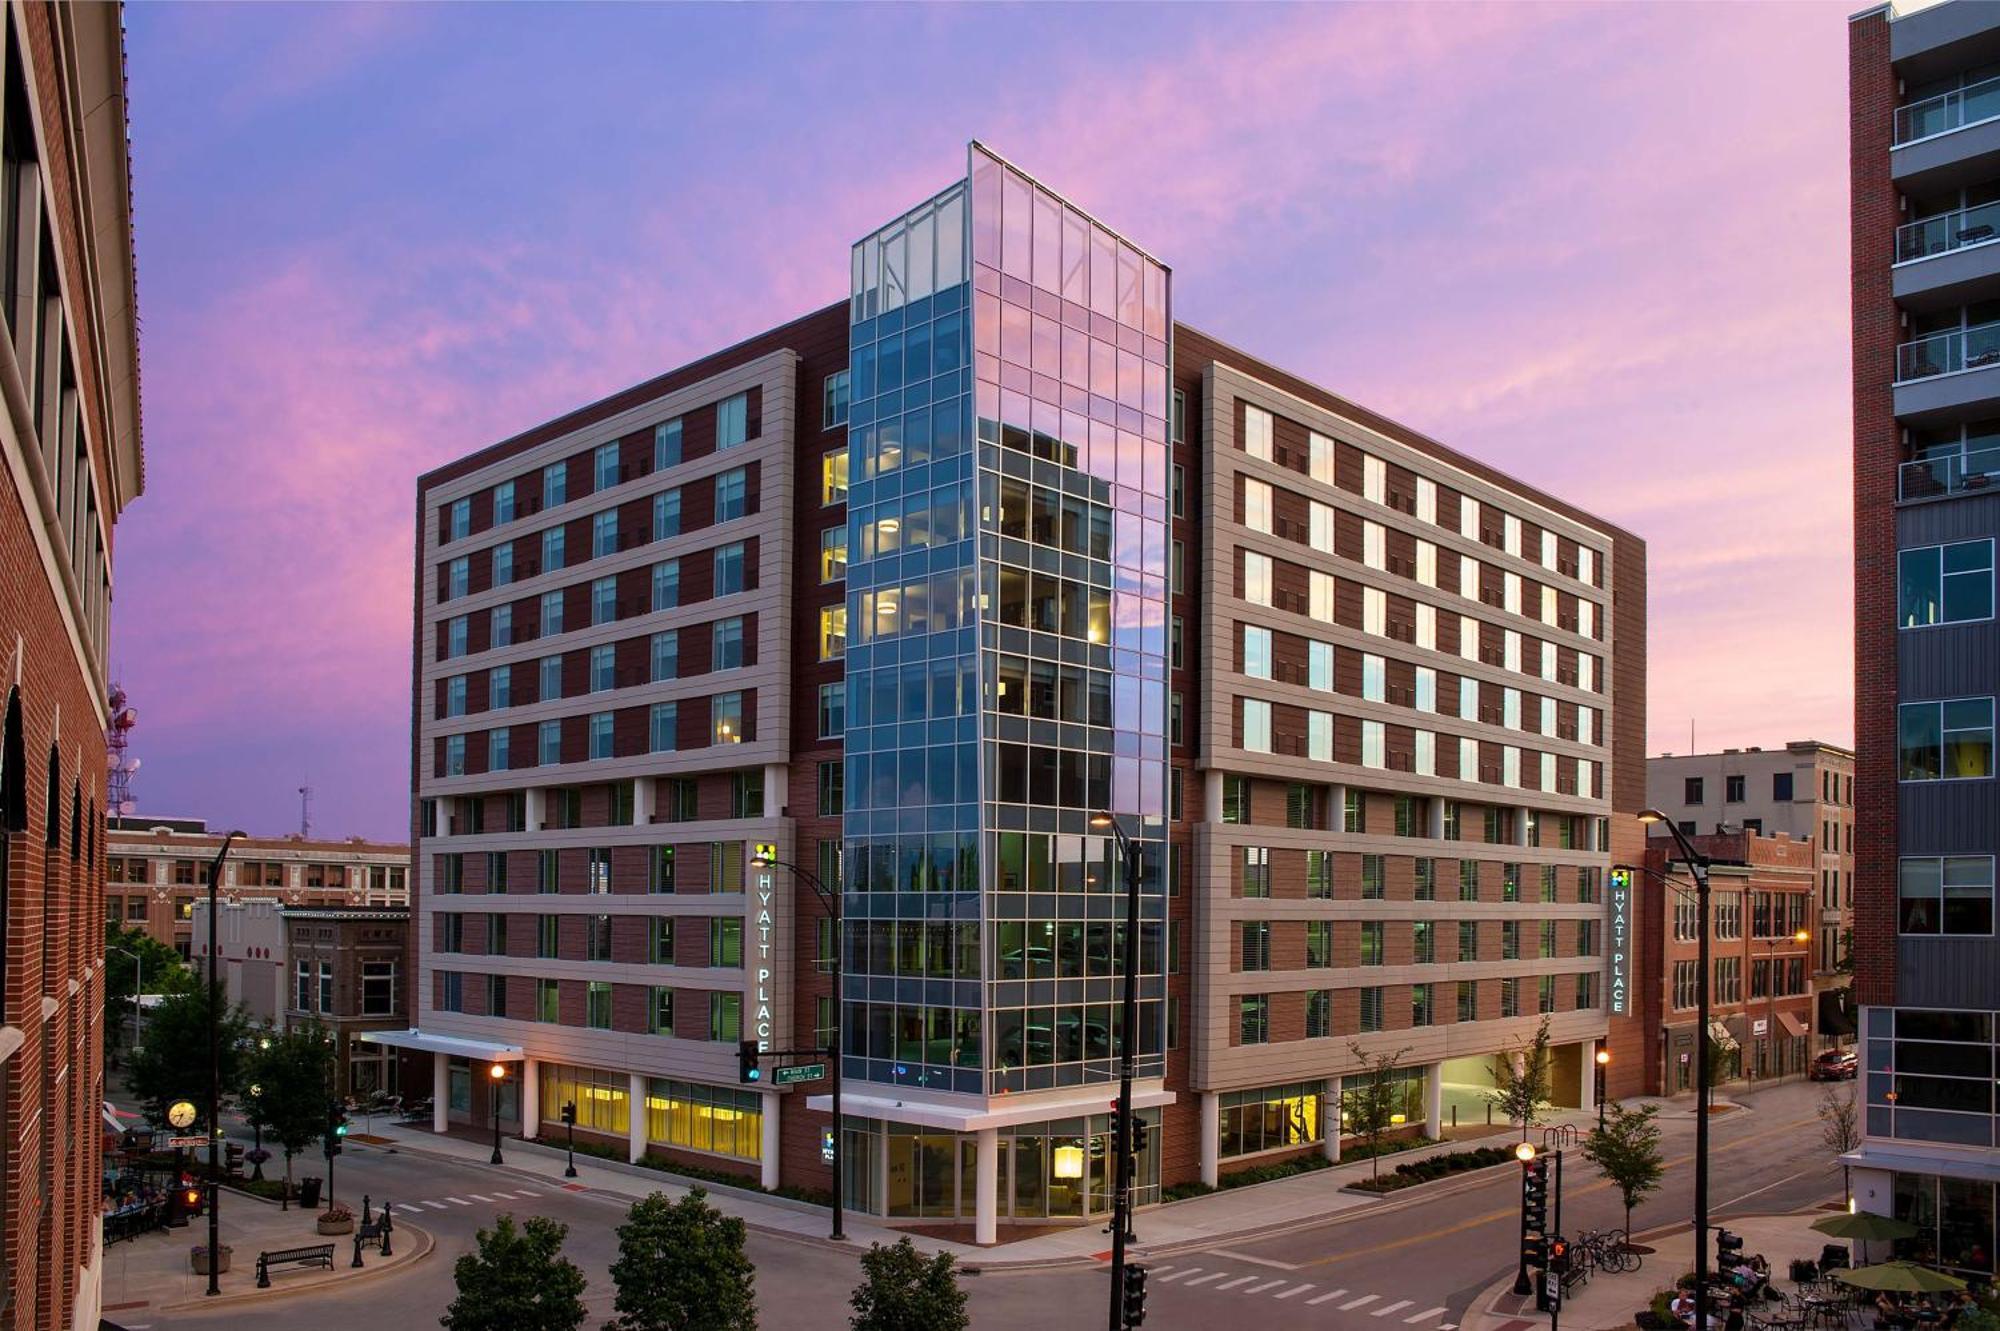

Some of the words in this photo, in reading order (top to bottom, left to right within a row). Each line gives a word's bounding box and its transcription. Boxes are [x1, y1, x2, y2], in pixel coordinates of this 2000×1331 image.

[759, 874, 771, 959] HYATT
[1614, 890, 1625, 948] HYATT
[758, 968, 770, 1053] PLACE
[1613, 953, 1624, 1012] PLACE
